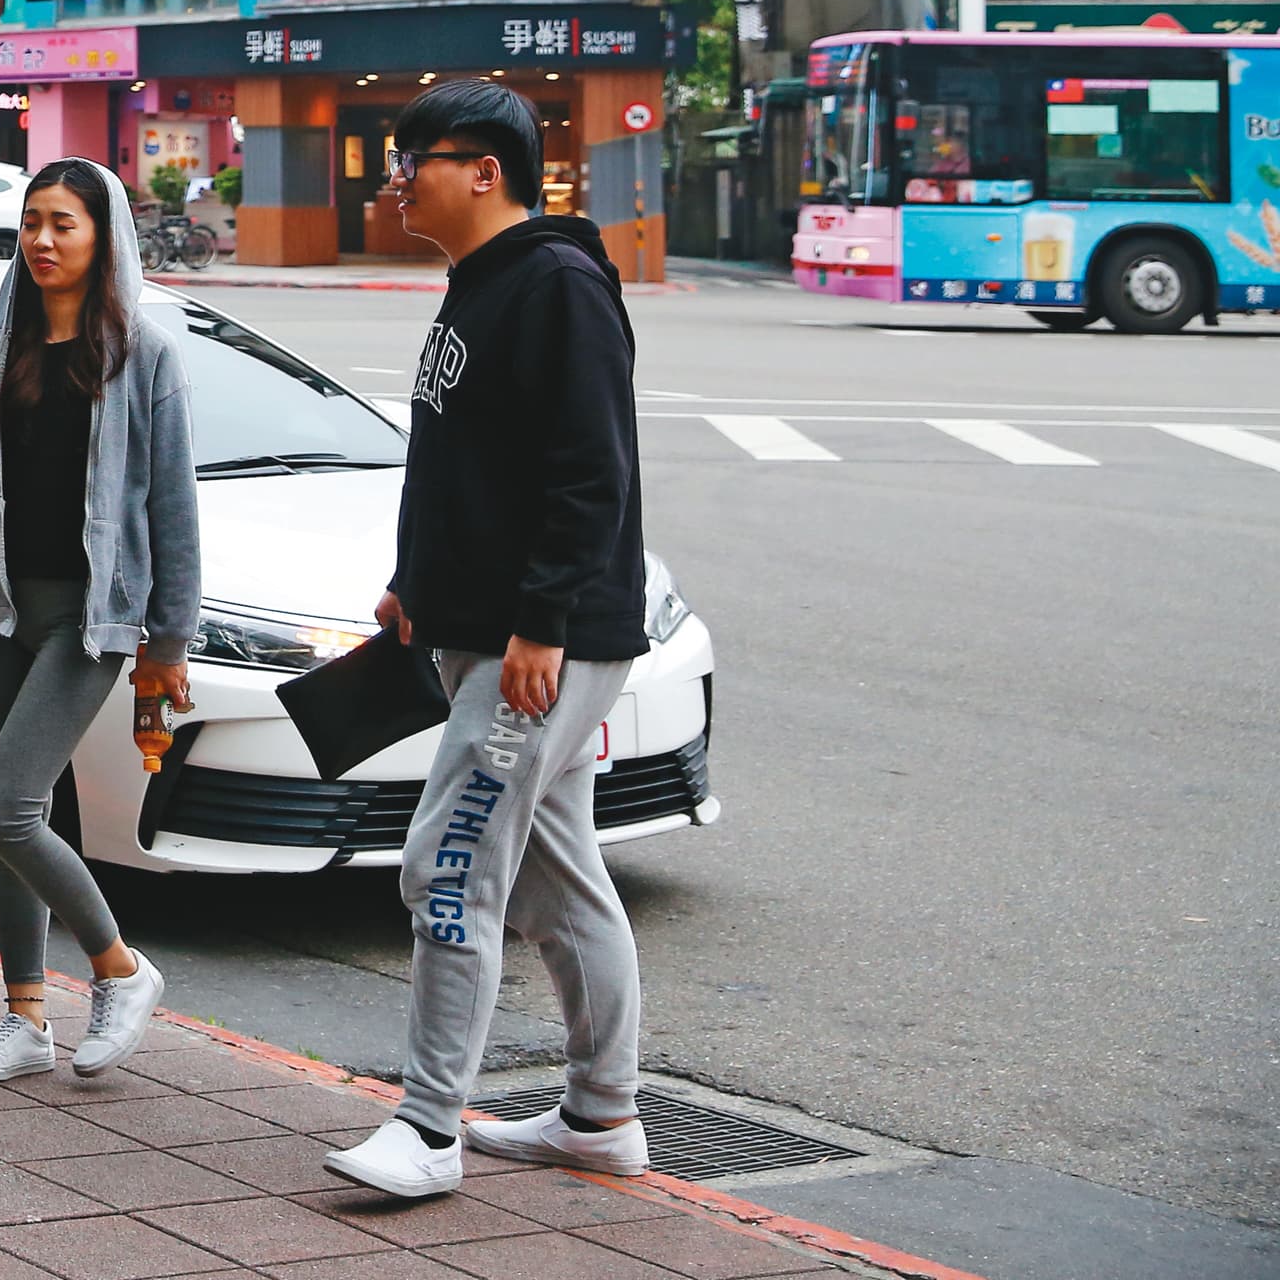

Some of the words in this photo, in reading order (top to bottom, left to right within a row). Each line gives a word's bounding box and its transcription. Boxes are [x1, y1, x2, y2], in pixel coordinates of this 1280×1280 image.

[289, 39, 322, 52] SUSHI
[582, 30, 637, 46] SUSHI
[429, 767, 506, 945] ATHLETICS
